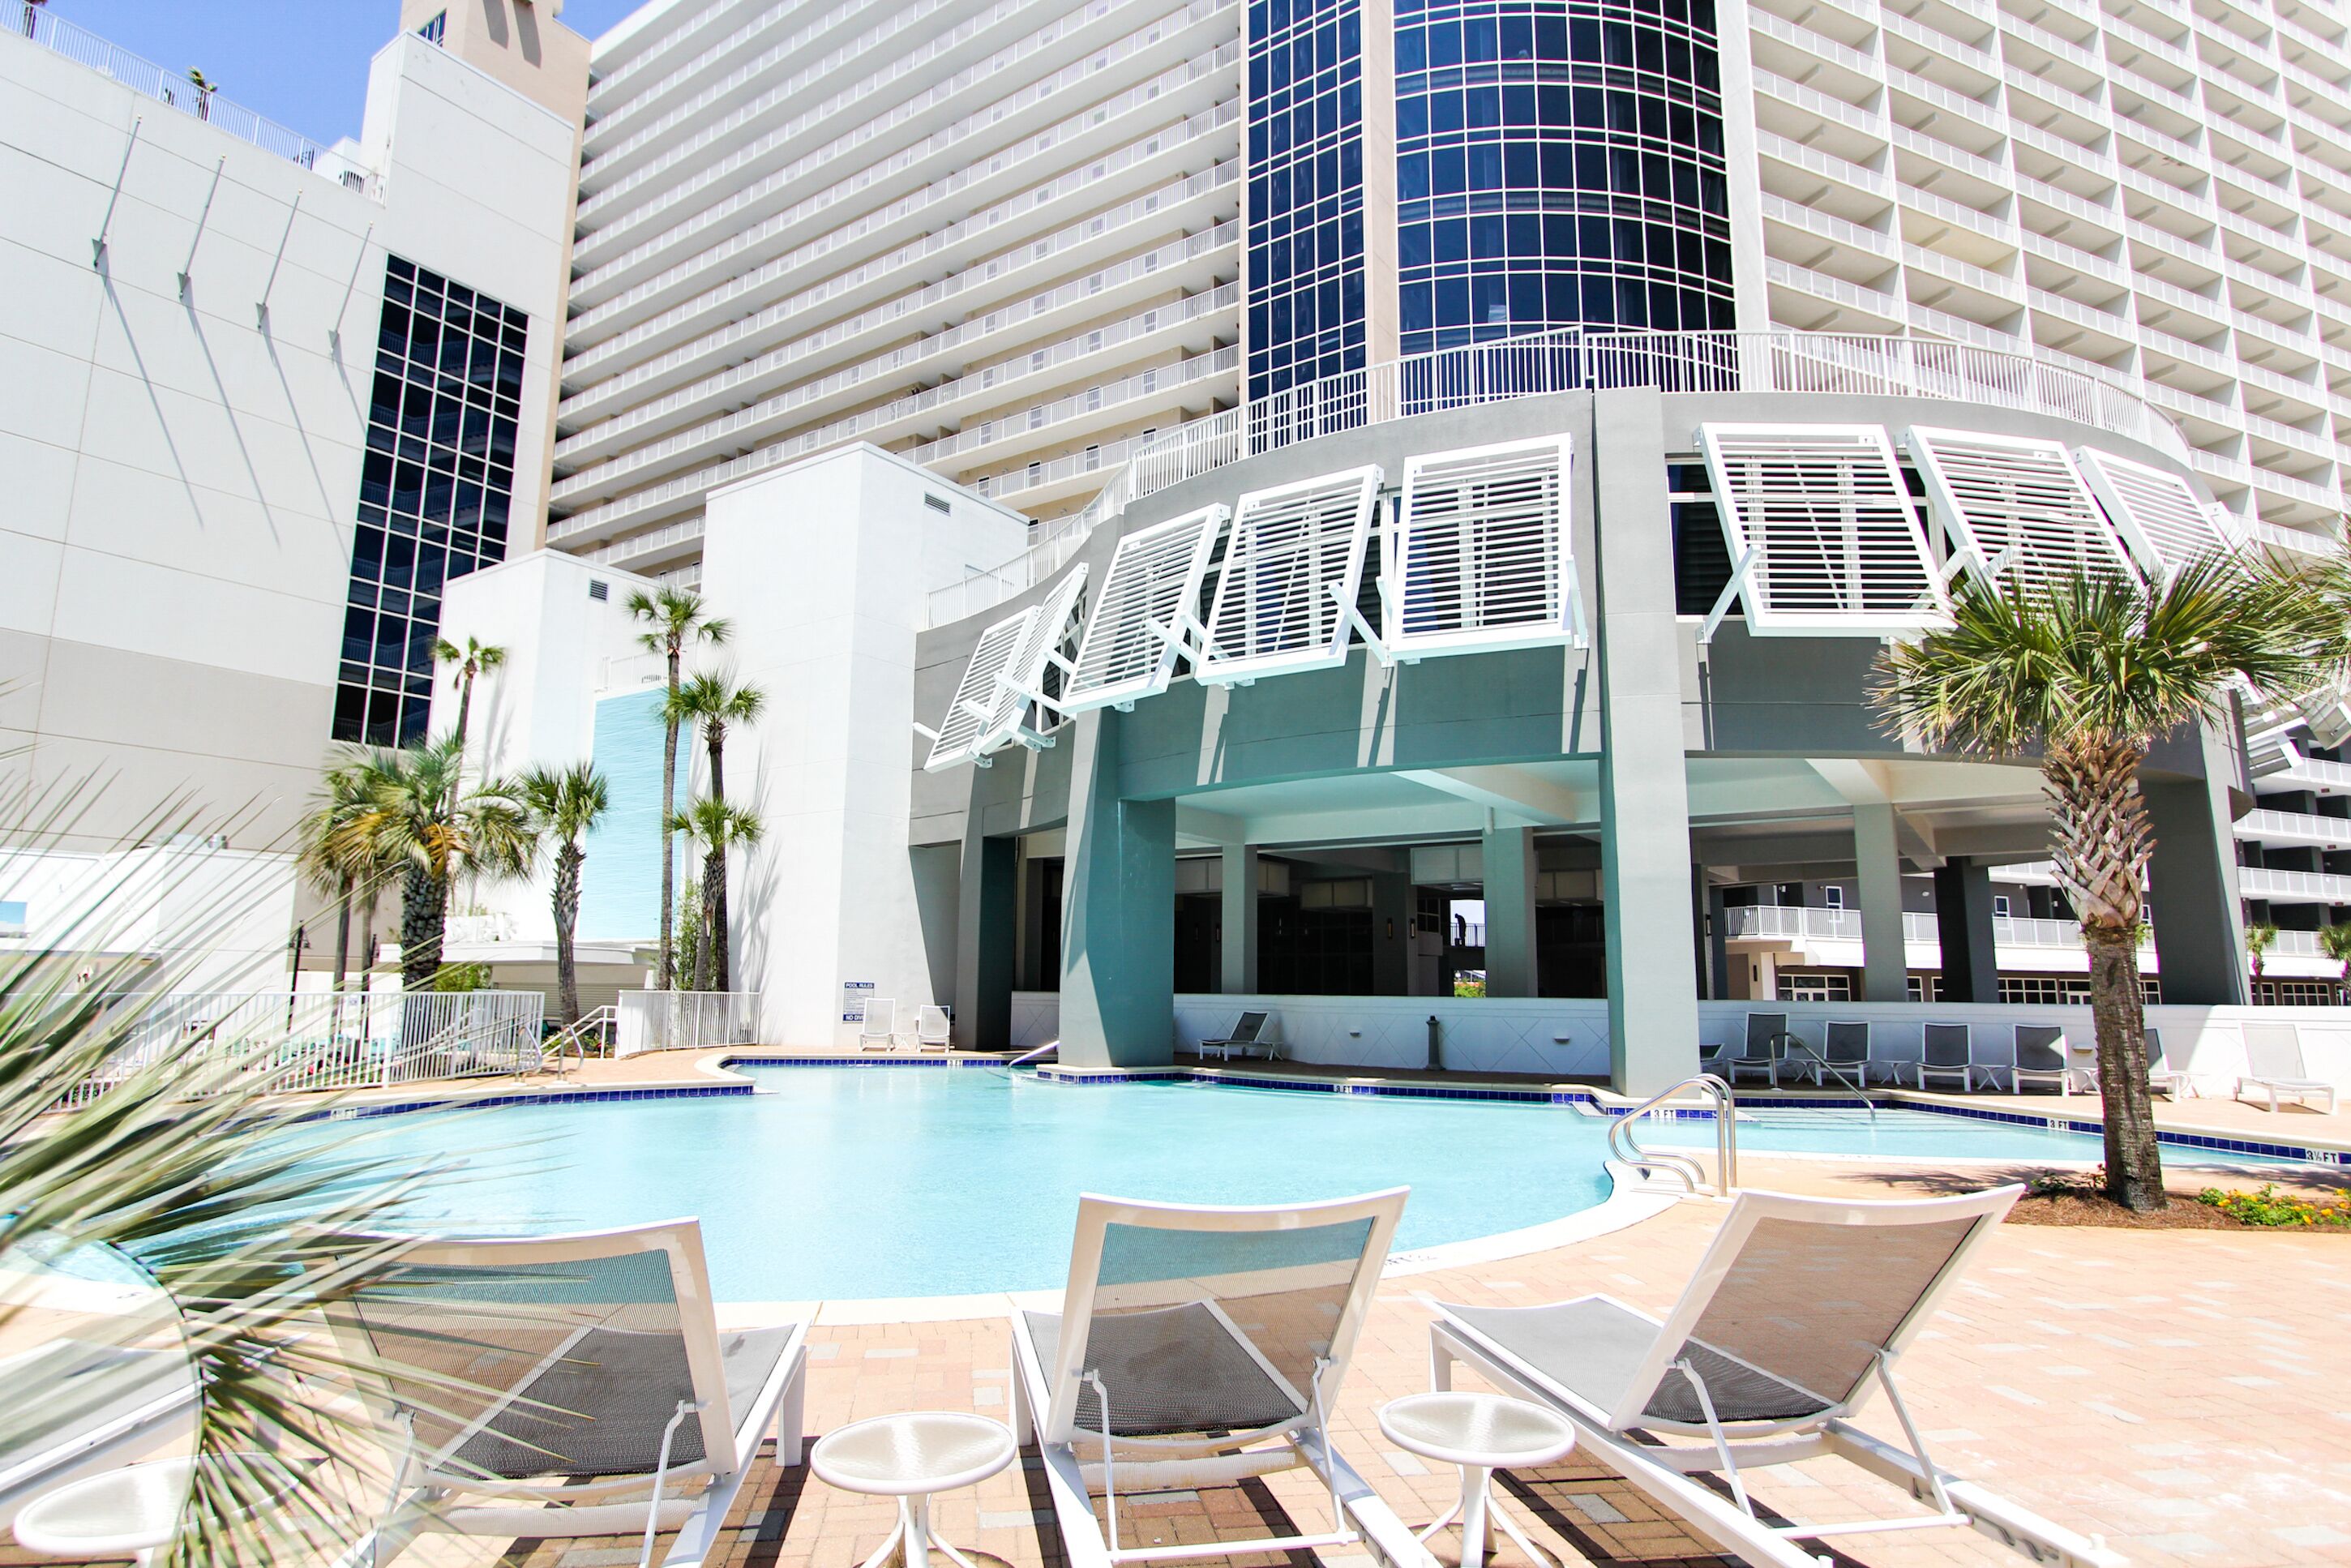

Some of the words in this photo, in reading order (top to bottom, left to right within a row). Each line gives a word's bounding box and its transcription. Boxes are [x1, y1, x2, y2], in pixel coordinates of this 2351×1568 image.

[1664, 1109, 1674, 1117] FT
[2050, 1120, 2055, 1128] 3
[2058, 1120, 2067, 1129] FT
